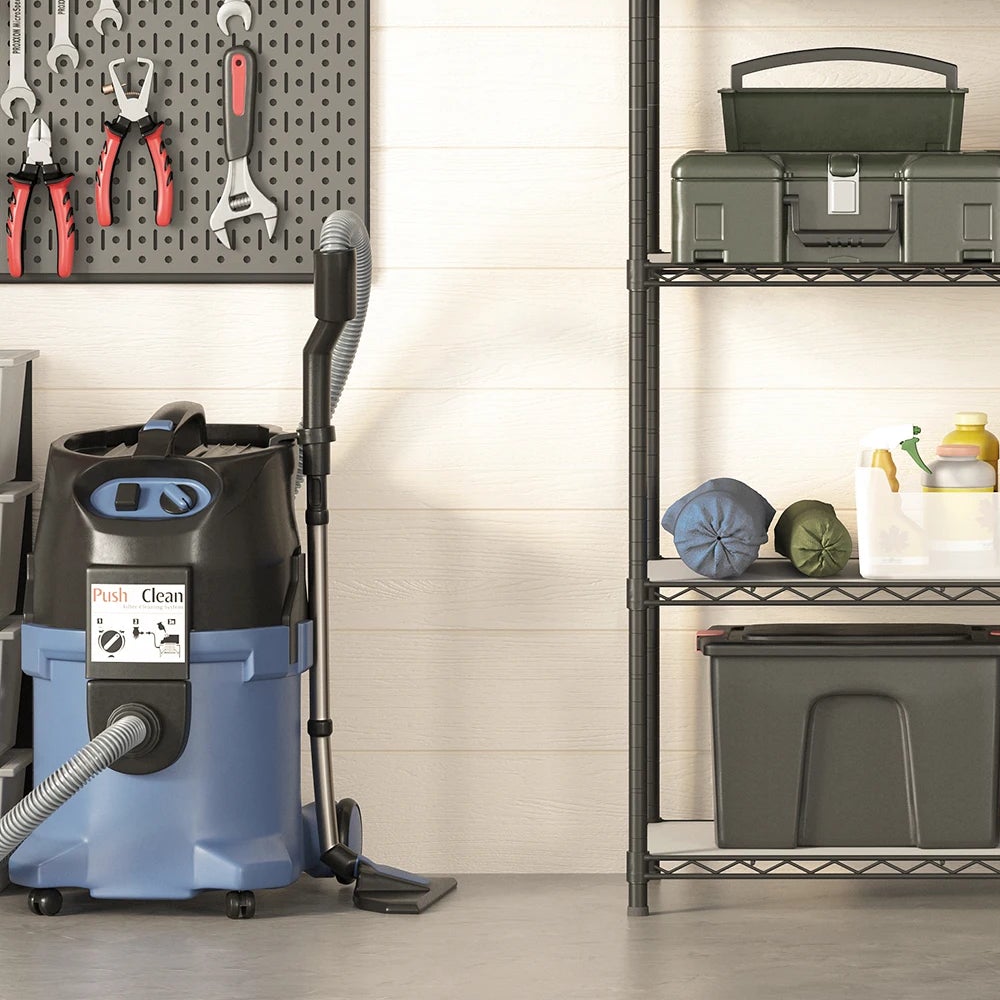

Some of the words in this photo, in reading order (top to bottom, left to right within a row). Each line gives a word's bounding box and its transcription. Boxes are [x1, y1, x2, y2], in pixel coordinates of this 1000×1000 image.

[12, 29, 21, 54] PROXXON
[93, 587, 128, 603] Push
[142, 587, 183, 603] Clean
